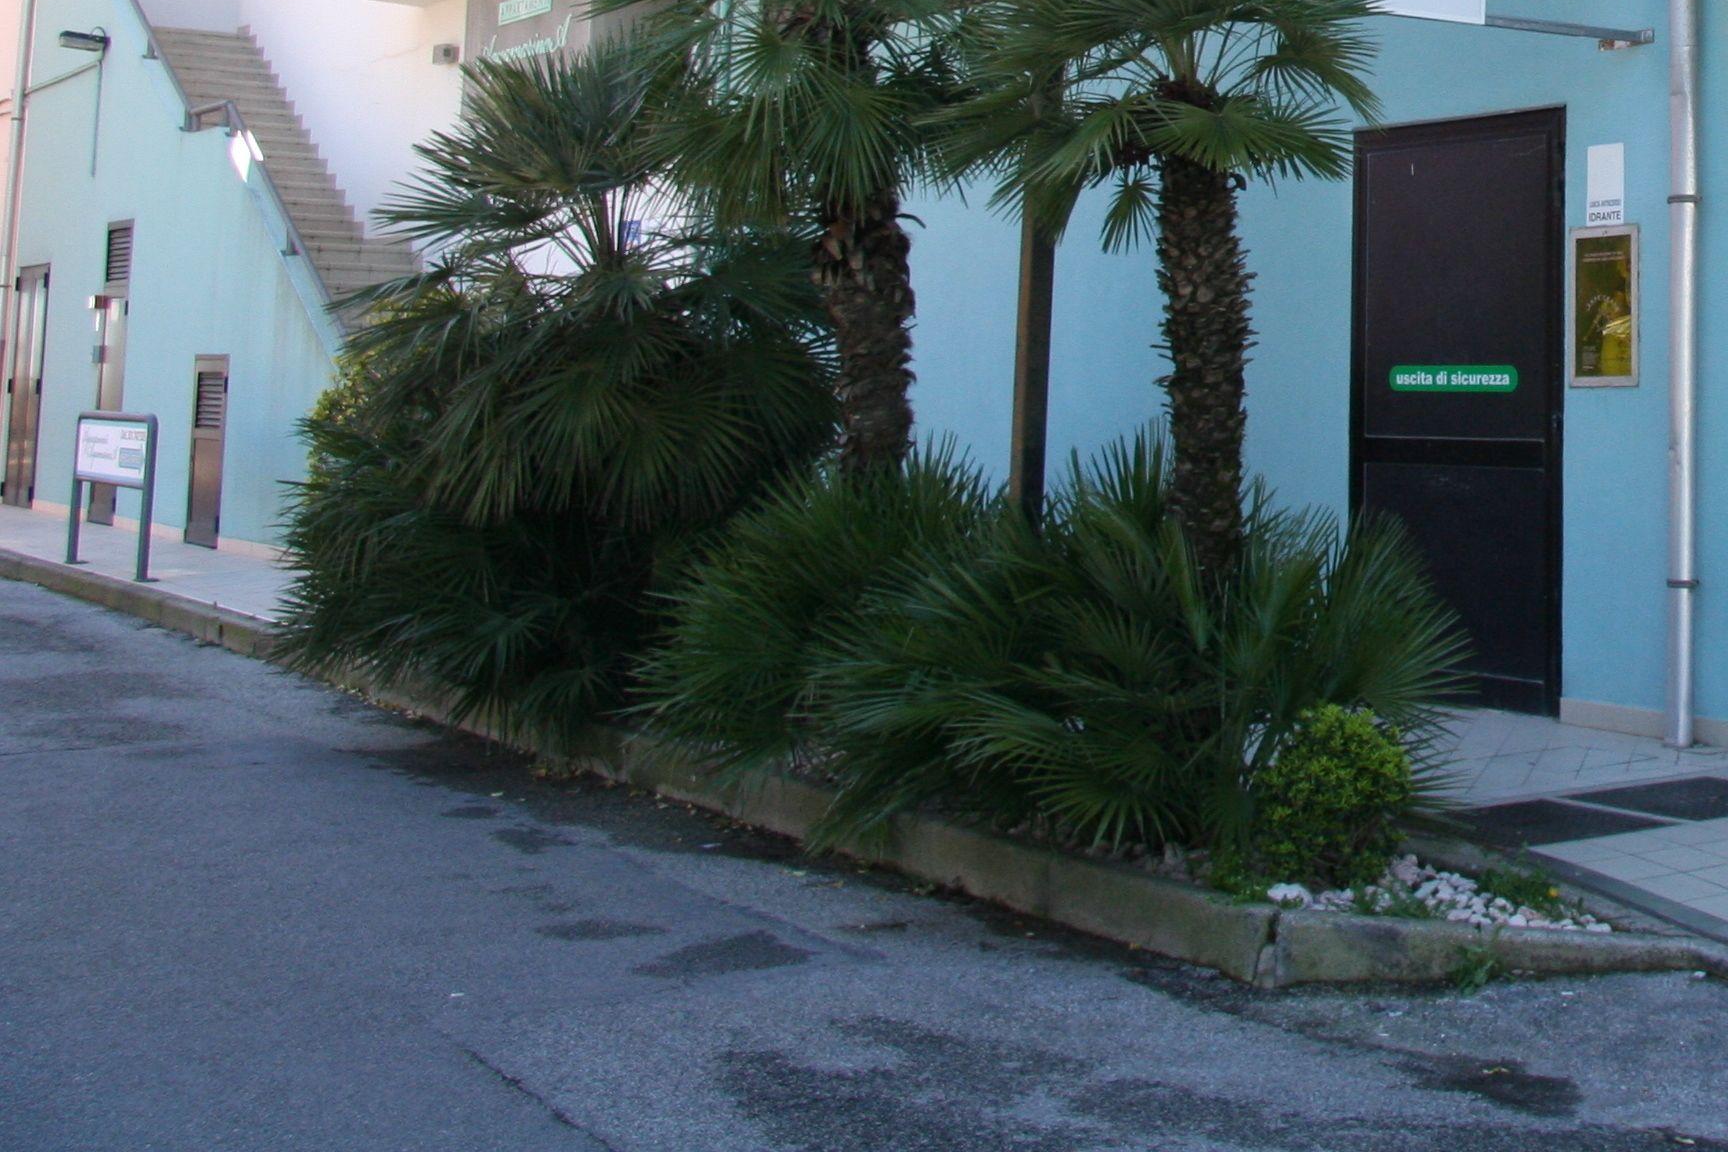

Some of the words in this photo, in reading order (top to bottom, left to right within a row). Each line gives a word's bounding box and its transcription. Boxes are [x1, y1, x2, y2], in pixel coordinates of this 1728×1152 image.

[1588, 210, 1622, 222] IDRANTE
[1396, 371, 1433, 385] uscita
[1436, 371, 1447, 385] di
[1450, 371, 1510, 385] sicurezza
